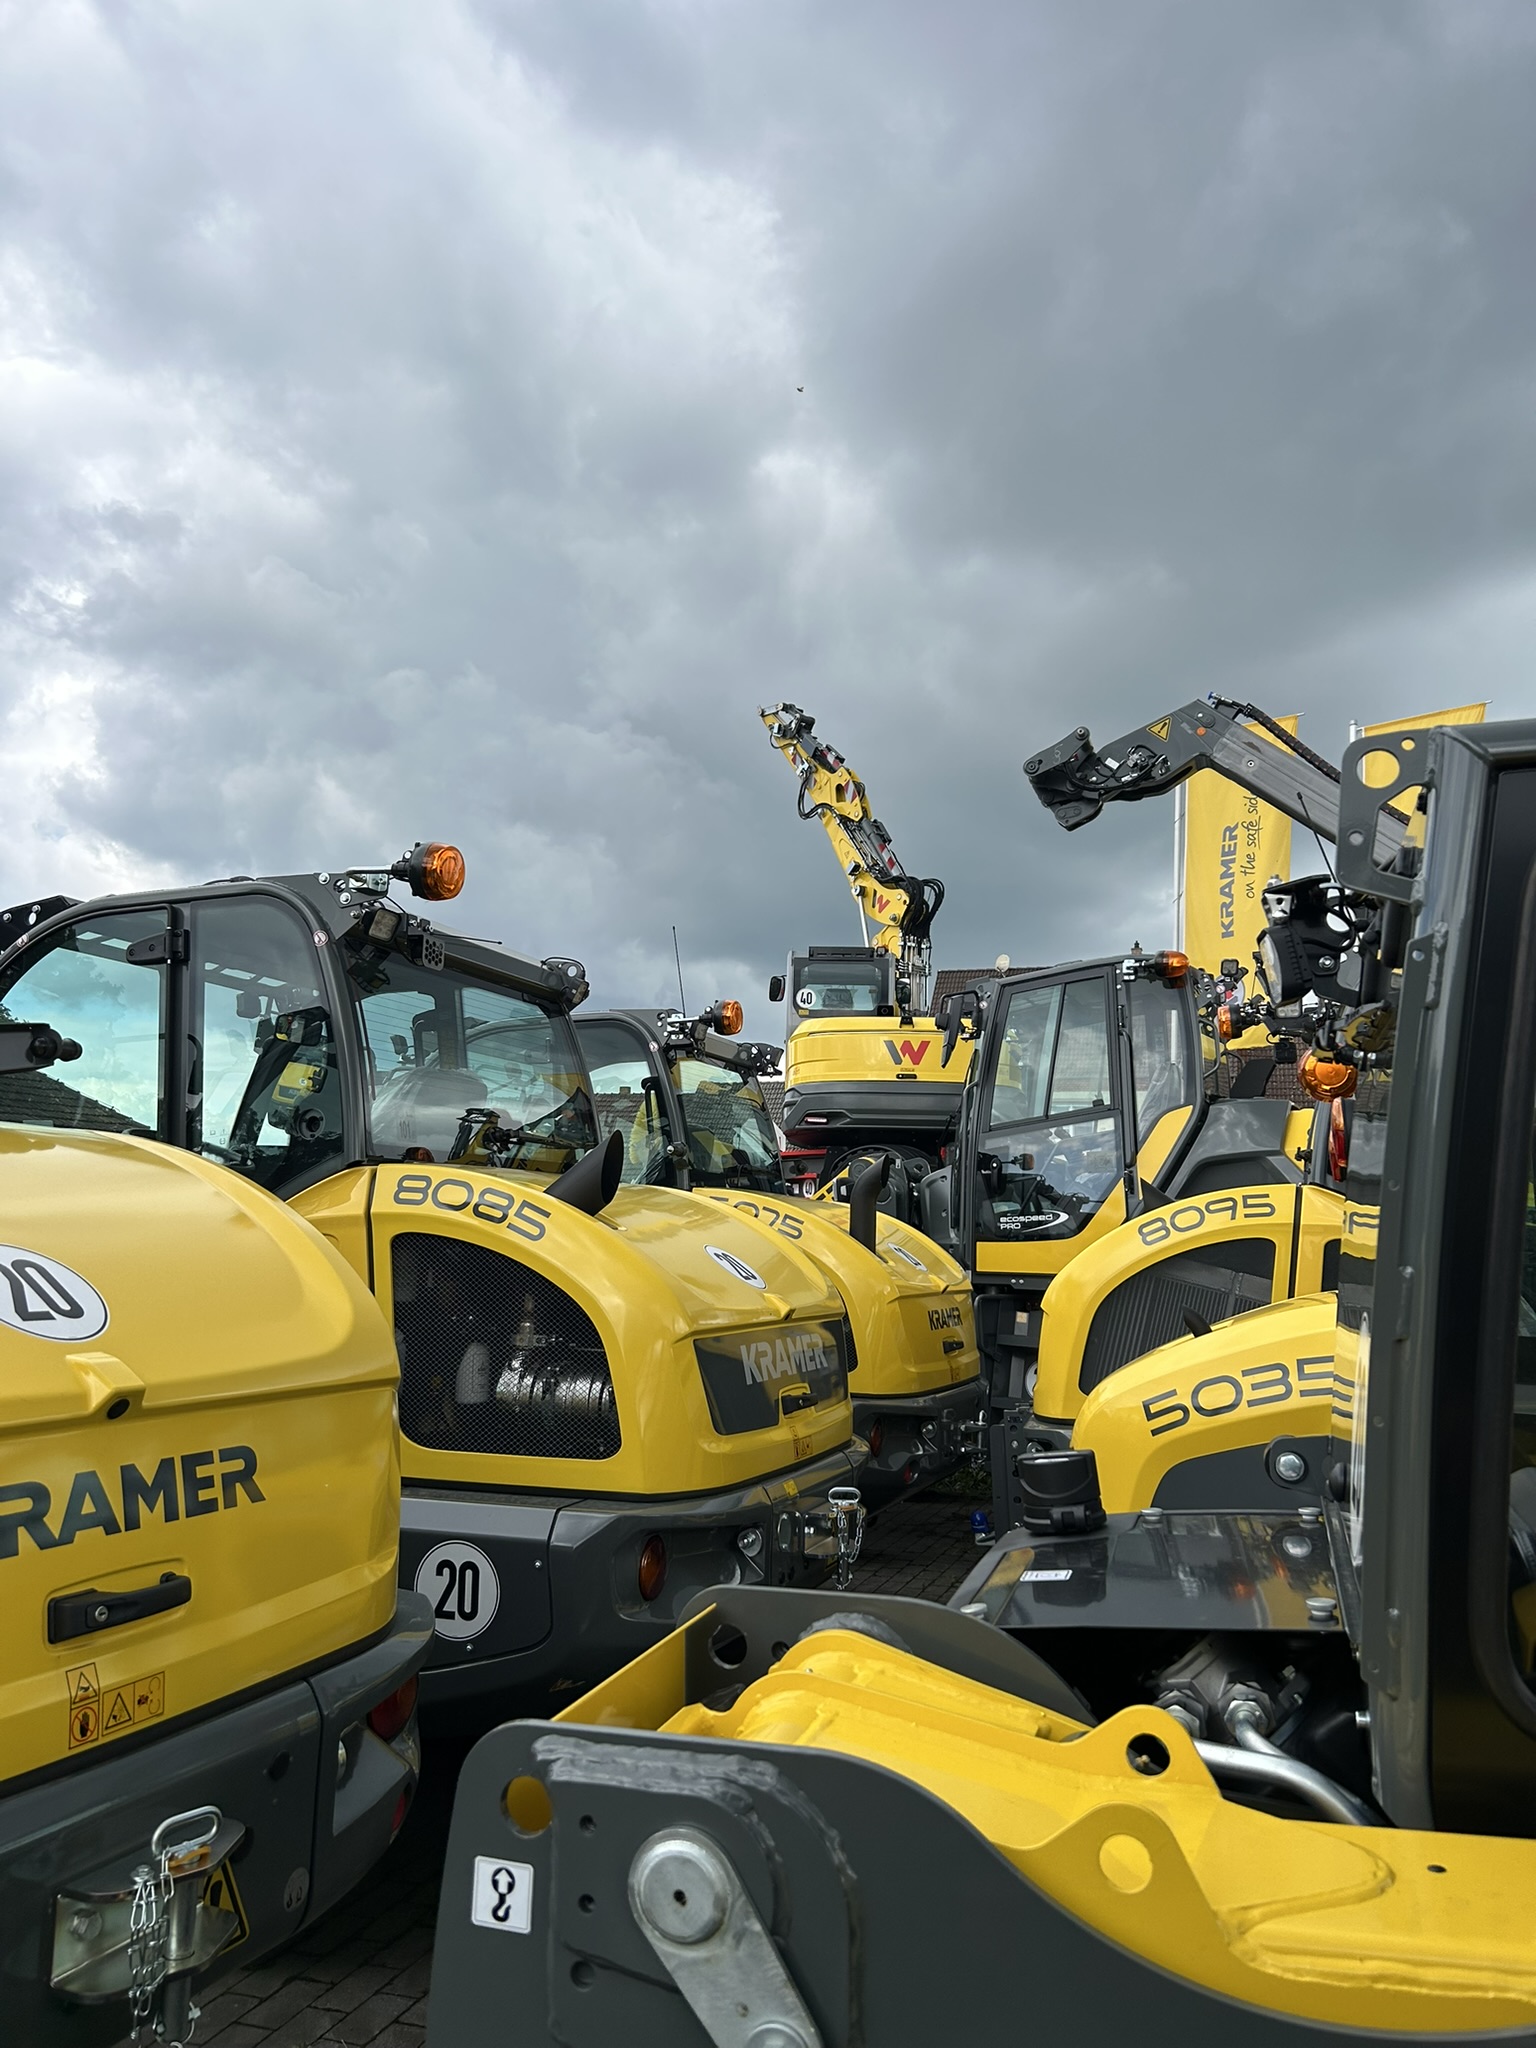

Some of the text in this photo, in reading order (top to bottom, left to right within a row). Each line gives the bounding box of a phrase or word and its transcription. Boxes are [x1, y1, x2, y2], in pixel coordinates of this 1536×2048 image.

[1240, 794, 1263, 899] on the safe sid
[1219, 821, 1239, 939] KRAMER
[800, 991, 813, 1005] 40
[393, 1174, 552, 1242] 8085
[709, 1196, 805, 1240] 075
[1000, 1213, 1053, 1223] ecospeed
[1000, 1222, 1021, 1230] PRO
[1137, 1193, 1276, 1246] 8095
[0, 1259, 85, 1322] 20
[713, 1252, 758, 1281] 20
[928, 1306, 963, 1331] KRAMER
[740, 1333, 828, 1386] KRAMER
[1141, 1355, 1335, 1437] 5035
[0, 1445, 267, 1560] RAMER
[434, 1559, 480, 1622] 20
